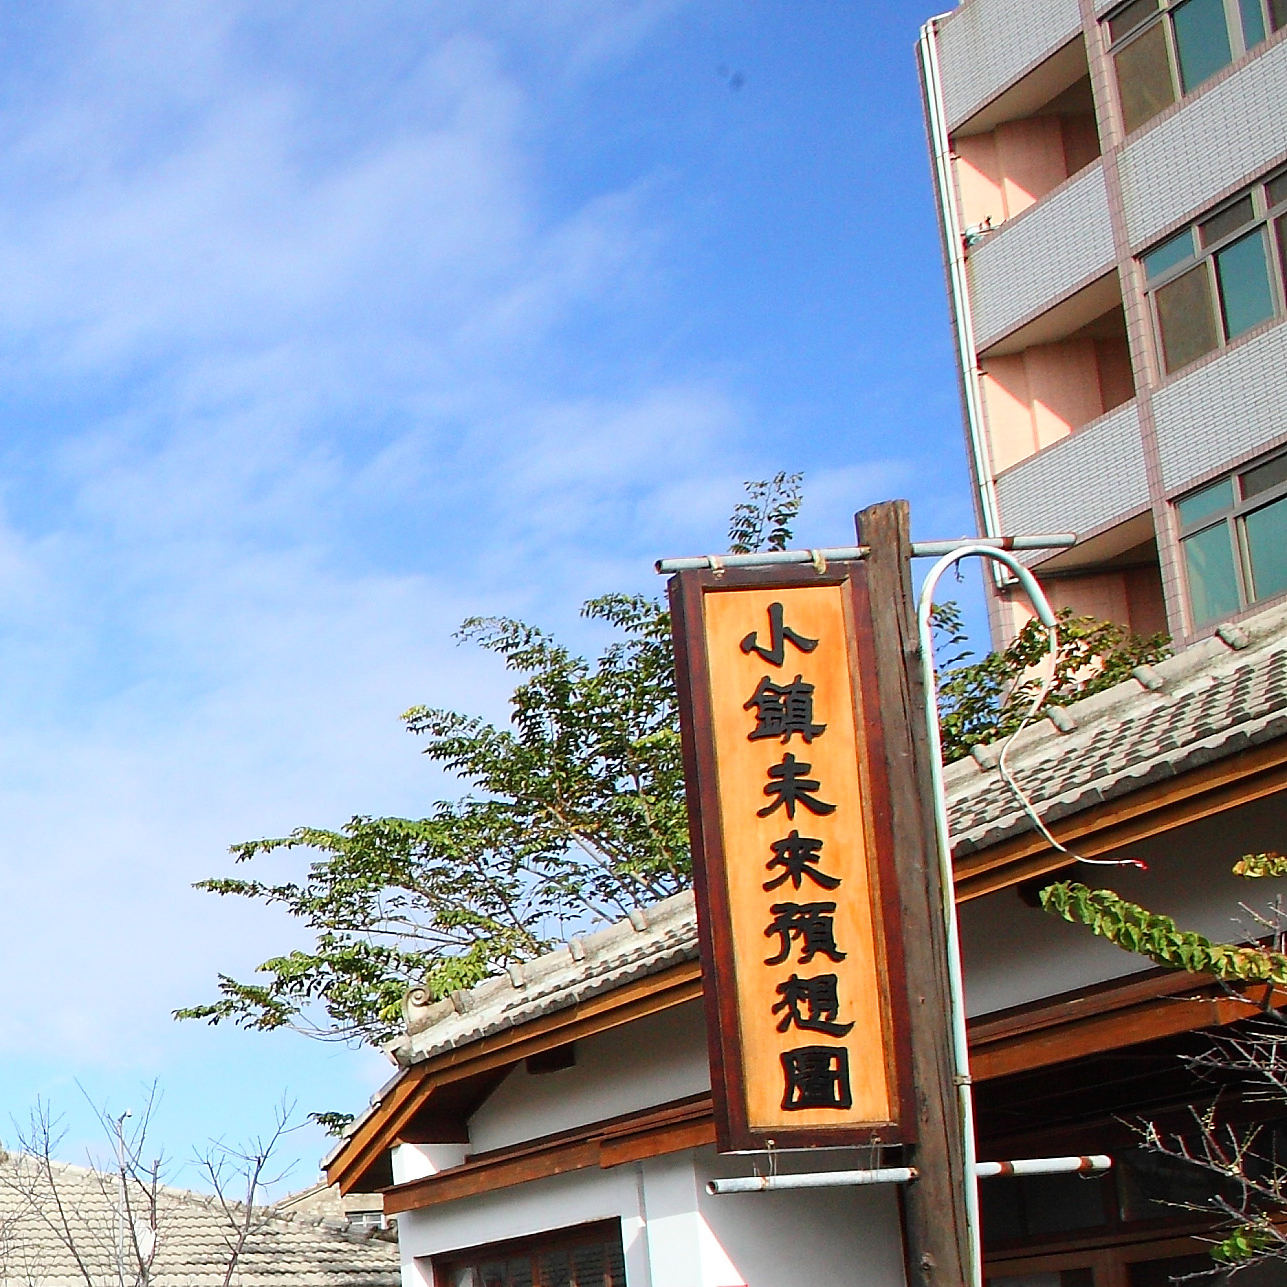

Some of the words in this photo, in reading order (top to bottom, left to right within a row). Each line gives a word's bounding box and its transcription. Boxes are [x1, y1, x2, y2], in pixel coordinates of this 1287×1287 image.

[739, 601, 856, 1112] 小鎮未來預想圖
